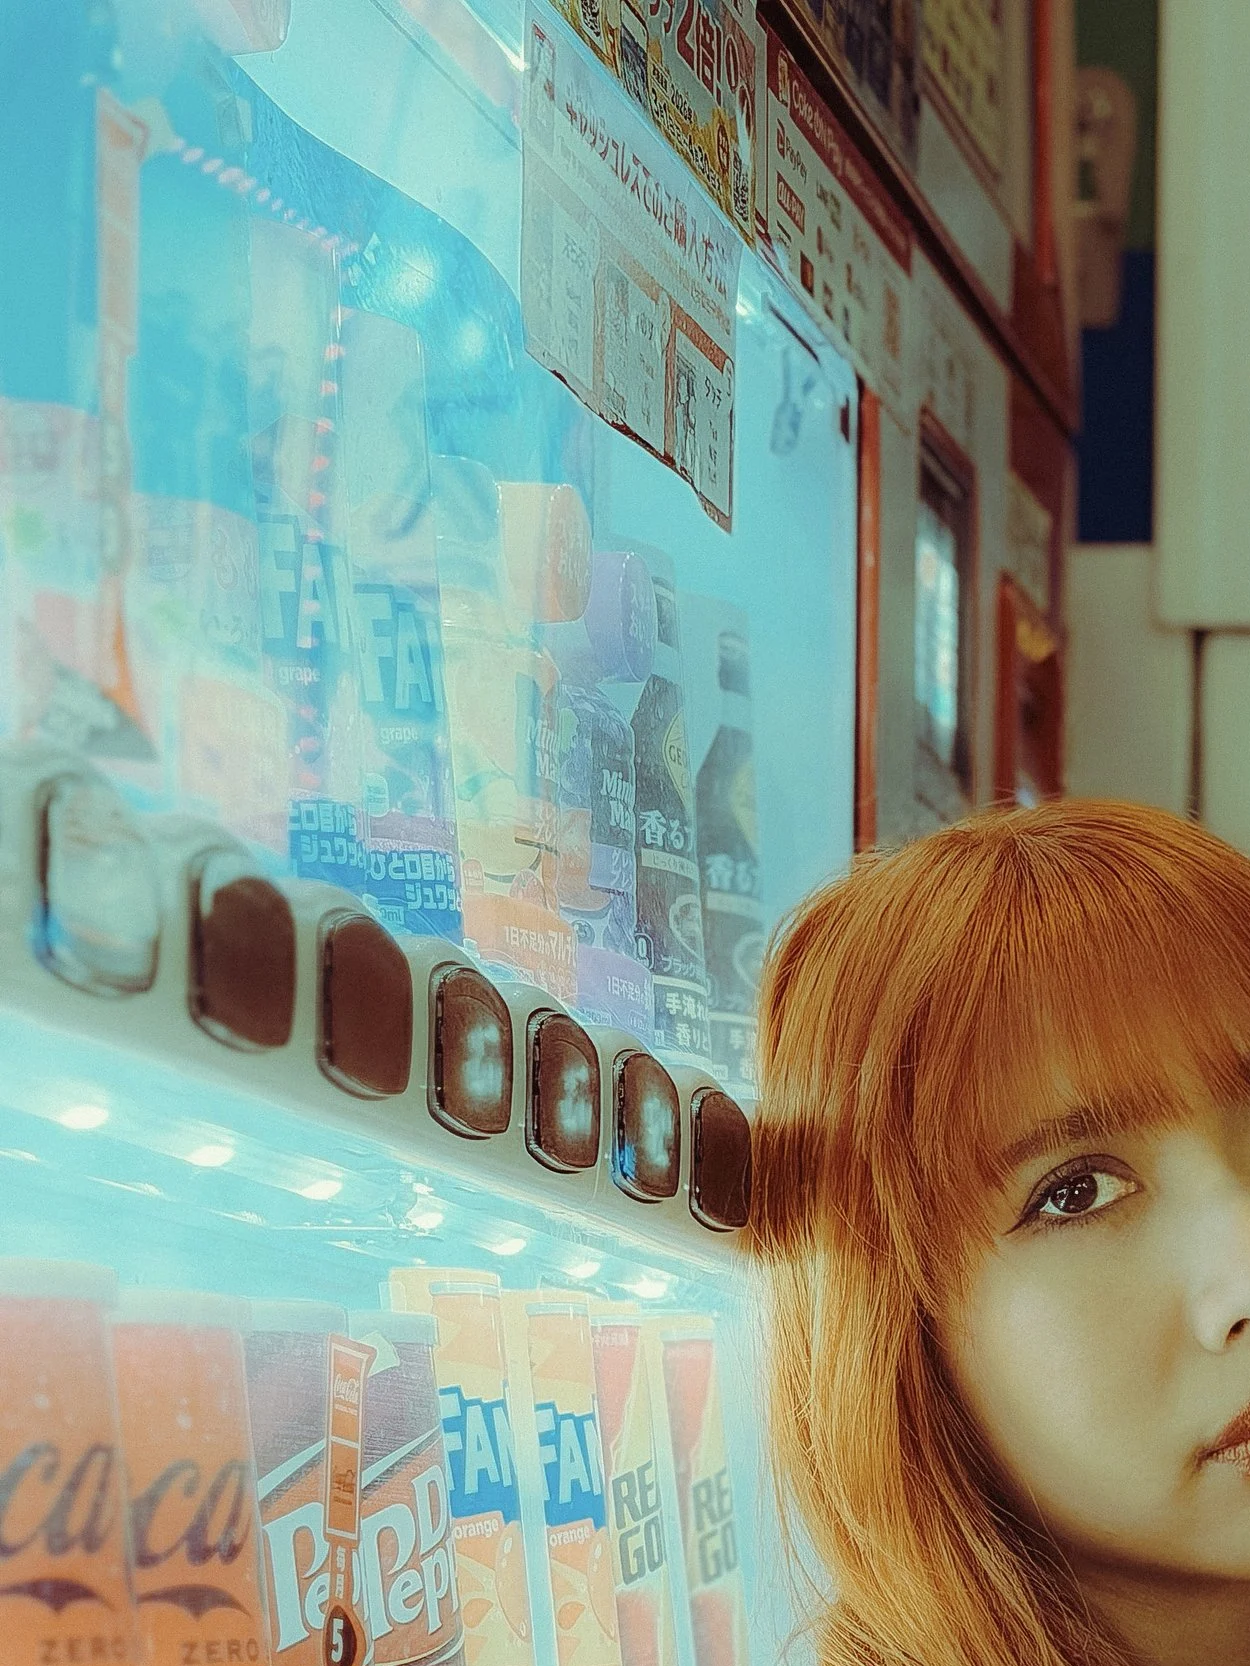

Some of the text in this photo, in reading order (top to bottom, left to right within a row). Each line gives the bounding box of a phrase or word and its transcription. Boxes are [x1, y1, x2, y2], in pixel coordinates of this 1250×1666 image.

[277, 665, 322, 689] grape
[380, 723, 420, 746] grape
[454, 1518, 500, 1540] orange
[549, 1526, 592, 1547] orange
[38, 1634, 128, 1666] ZERO
[181, 1636, 261, 1666] ZERO
[331, 1618, 344, 1663] 5
